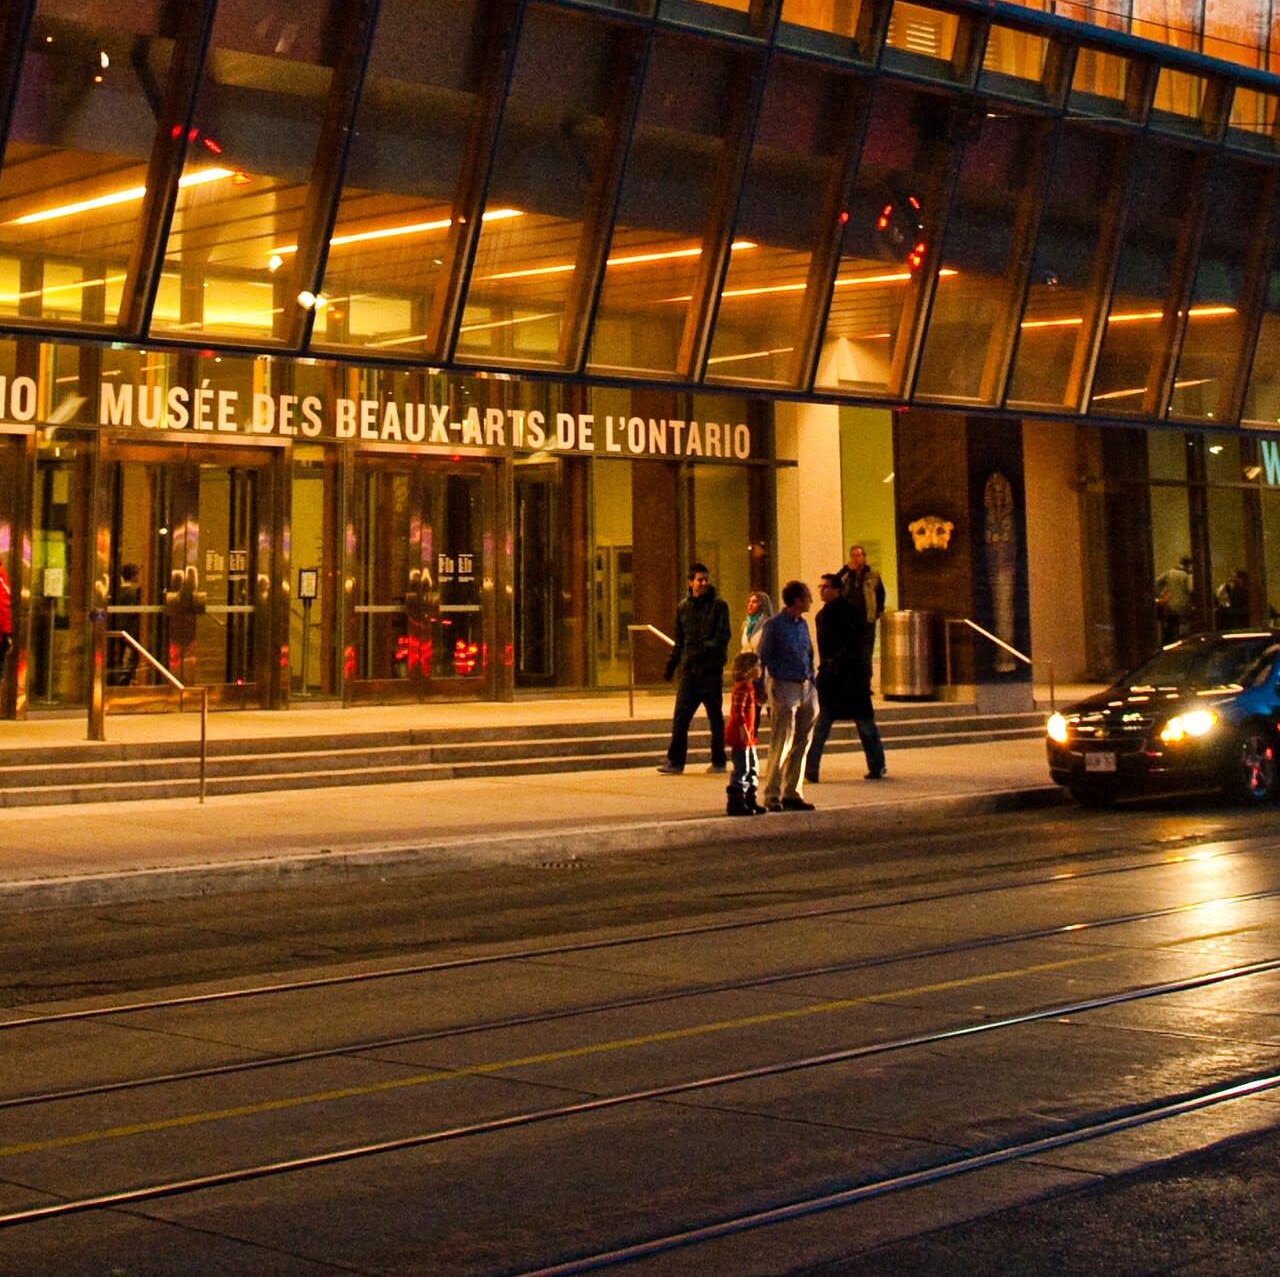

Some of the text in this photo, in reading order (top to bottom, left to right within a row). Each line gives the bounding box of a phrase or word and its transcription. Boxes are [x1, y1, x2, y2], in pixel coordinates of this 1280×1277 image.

[100, 379, 751, 460] MUSÉE DES BEAUX-ARTS DE L'ONTARIO
